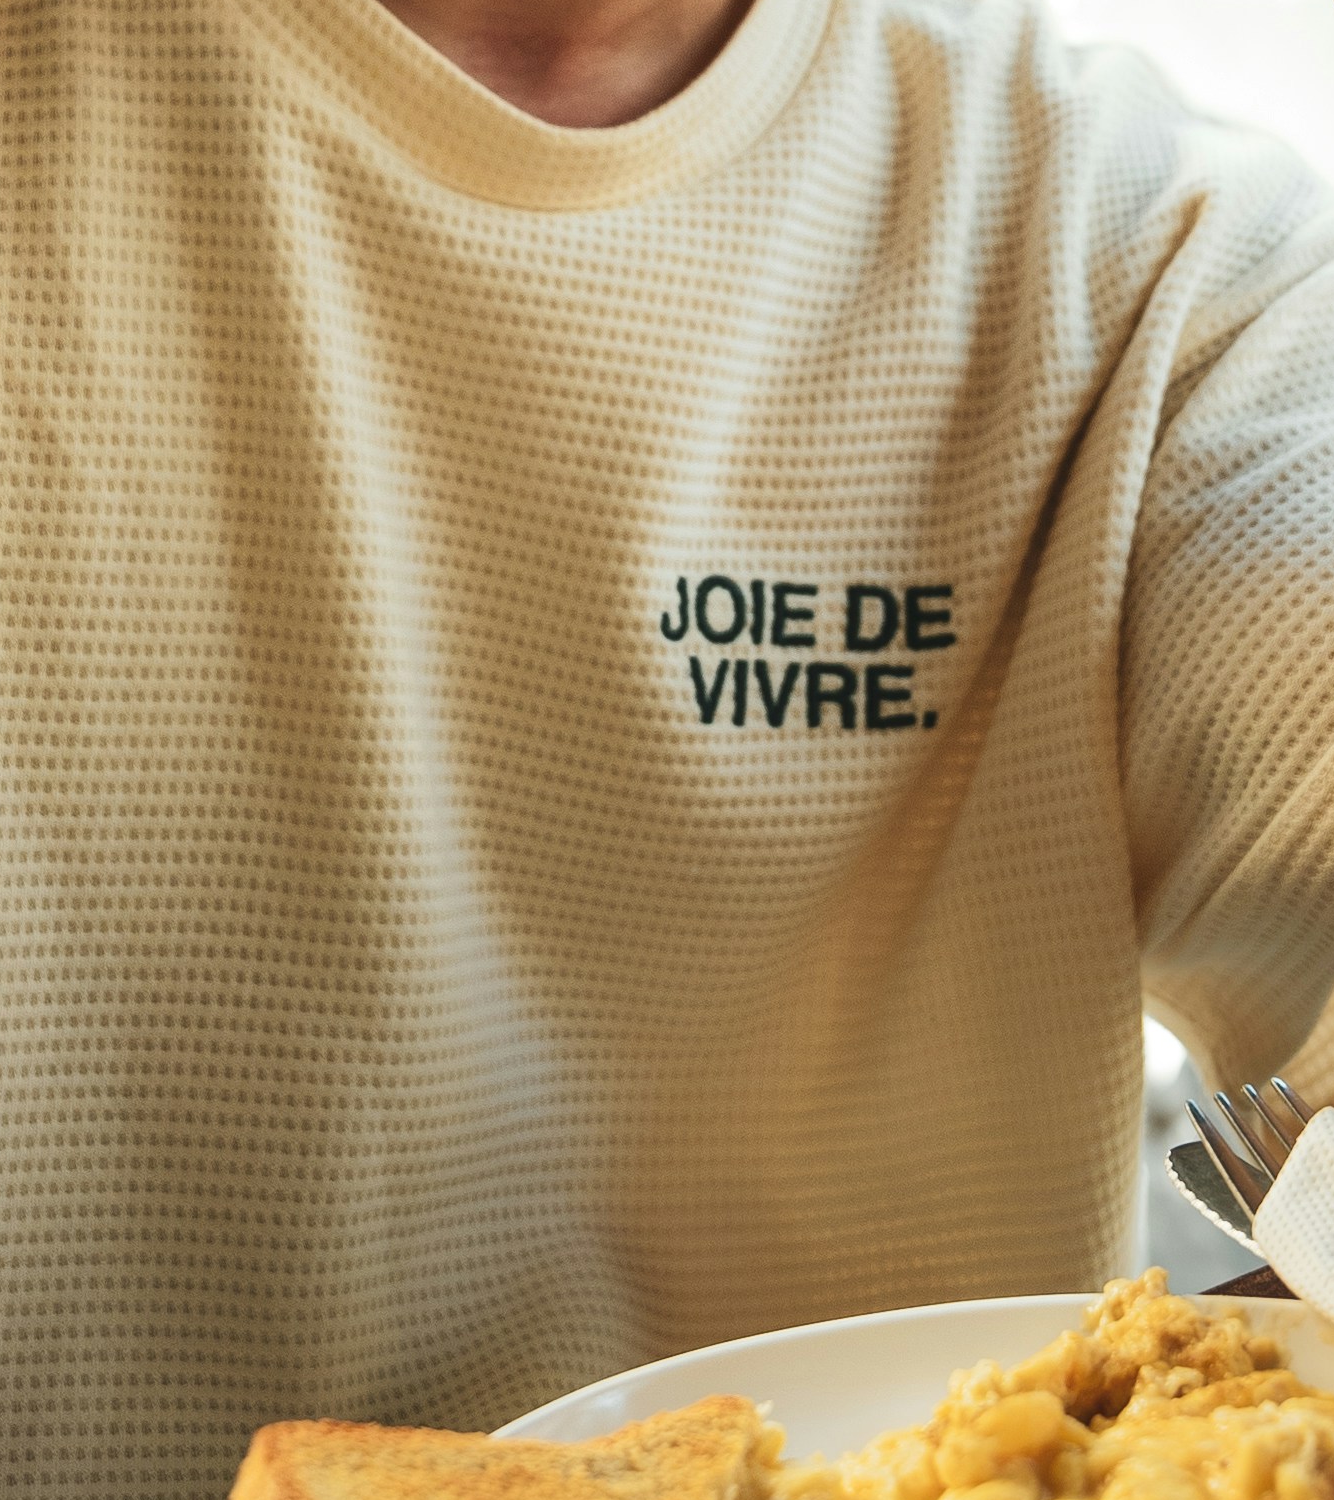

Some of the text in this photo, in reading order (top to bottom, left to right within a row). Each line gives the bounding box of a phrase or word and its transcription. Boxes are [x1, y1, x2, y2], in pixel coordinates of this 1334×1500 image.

[661, 575, 957, 652] JOIE DE
[688, 655, 938, 730] VIVRE.
